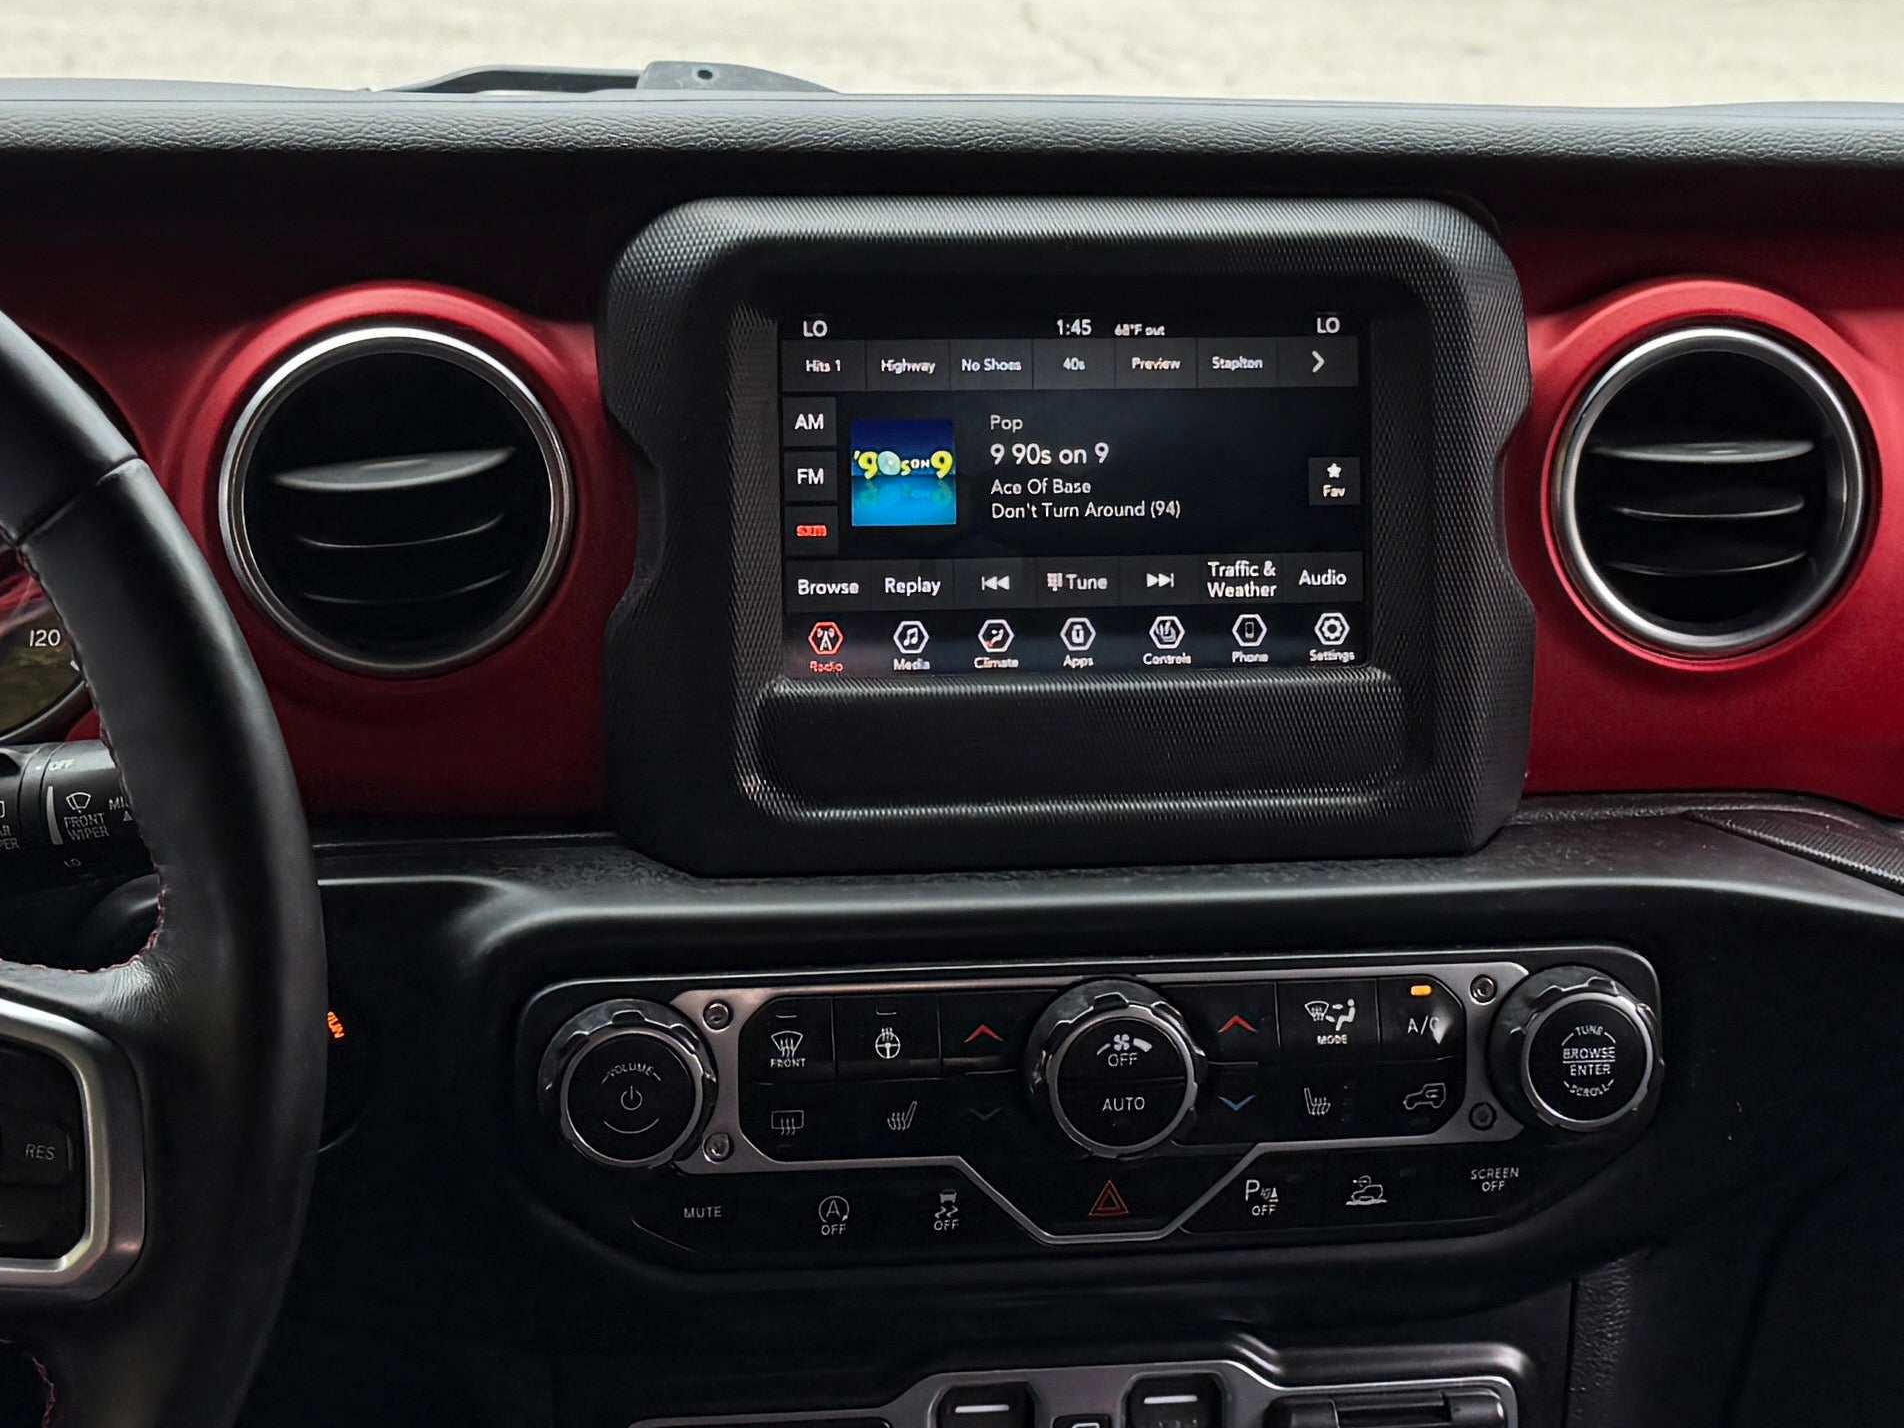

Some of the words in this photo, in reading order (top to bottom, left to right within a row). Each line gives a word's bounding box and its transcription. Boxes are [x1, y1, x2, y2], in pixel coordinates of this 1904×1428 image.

[802, 320, 828, 338] LO
[1056, 318, 1093, 336] 1:45
[1145, 324, 1166, 337] out
[1316, 317, 1341, 334] LO
[805, 359, 831, 373] Hits
[835, 359, 841, 372] 1
[880, 358, 936, 375] Highway
[961, 358, 981, 372] No
[983, 357, 1022, 372] Shoes
[1131, 356, 1181, 370] Preview
[794, 413, 824, 430] AM
[990, 415, 1024, 435] Pop
[989, 443, 1006, 465] 9
[1011, 443, 1053, 465] 90s
[1058, 447, 1088, 465] on
[1094, 441, 1110, 465] 9
[930, 450, 954, 479] 9
[796, 467, 824, 485] FM
[990, 478, 1022, 495] Ace
[1027, 476, 1049, 495] Of
[1054, 477, 1092, 495] Base
[1322, 484, 1346, 498] Fav
[991, 500, 1038, 520] Don't
[1040, 500, 1080, 519] Turn
[1084, 499, 1146, 519] Around
[1150, 498, 1181, 521] (94)
[1207, 560, 1259, 578] Traffic
[1263, 560, 1277, 577] &
[1066, 573, 1108, 590] Tune
[1298, 569, 1347, 586] Audio
[797, 578, 860, 596] Browse
[884, 575, 941, 597] Replay
[1207, 581, 1277, 599] Weather
[28, 629, 62, 647] 120
[973, 656, 1019, 670] Climate
[1062, 654, 1094, 669] Apps
[1142, 652, 1192, 666] Controls
[1231, 651, 1269, 663] Phone
[1309, 648, 1356, 663] Settings
[809, 660, 844, 673] Radio
[893, 658, 931, 671] Media
[64, 812, 106, 829] FRONT
[68, 826, 110, 842] WIPER
[1316, 1034, 1349, 1046] MODE
[1107, 1051, 1139, 1068] OFF
[1562, 1045, 1616, 1060] BROWSE
[769, 1057, 807, 1069] FRONT
[1569, 1063, 1611, 1076] ENTER
[1101, 1096, 1146, 1113] AUTO
[24, 1143, 56, 1161] RES
[1470, 1165, 1520, 1181] SCREEN
[1481, 1178, 1507, 1192] OFF
[683, 1205, 723, 1219] MUTE
[1251, 1203, 1278, 1217] OFF
[820, 1223, 847, 1237] OFF
[933, 1218, 960, 1232] OFF
